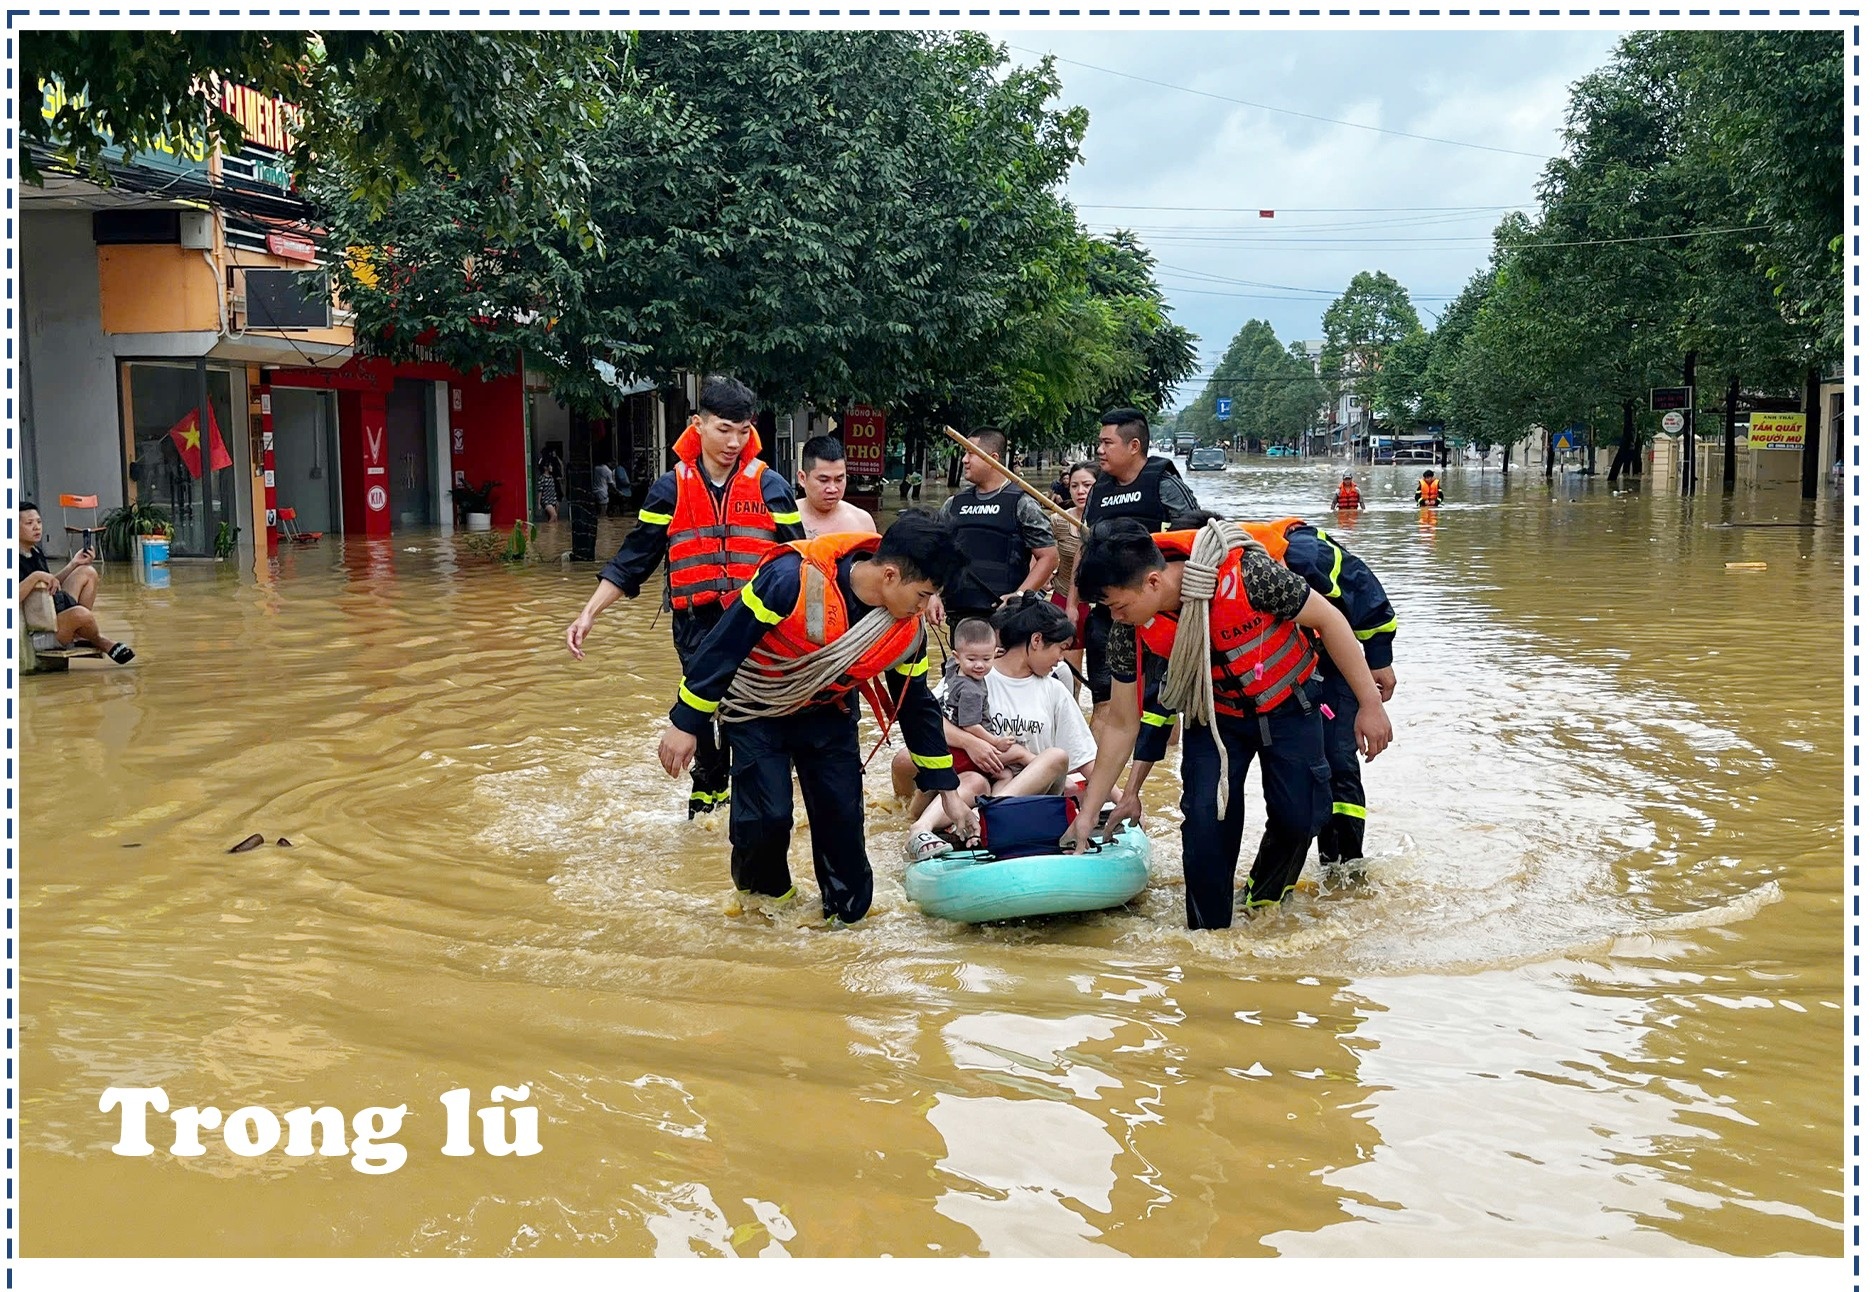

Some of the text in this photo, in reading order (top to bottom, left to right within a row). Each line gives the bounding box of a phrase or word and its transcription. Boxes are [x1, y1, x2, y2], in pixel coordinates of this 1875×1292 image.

[222, 80, 285, 151] CAMERA
[852, 417, 876, 438] ĐỒ
[846, 441, 881, 459] THỜ
[734, 500, 768, 515] CAND
[1100, 490, 1142, 507] SAKINNO
[959, 504, 1000, 515] SAKINNO
[1221, 616, 1263, 641] CAND
